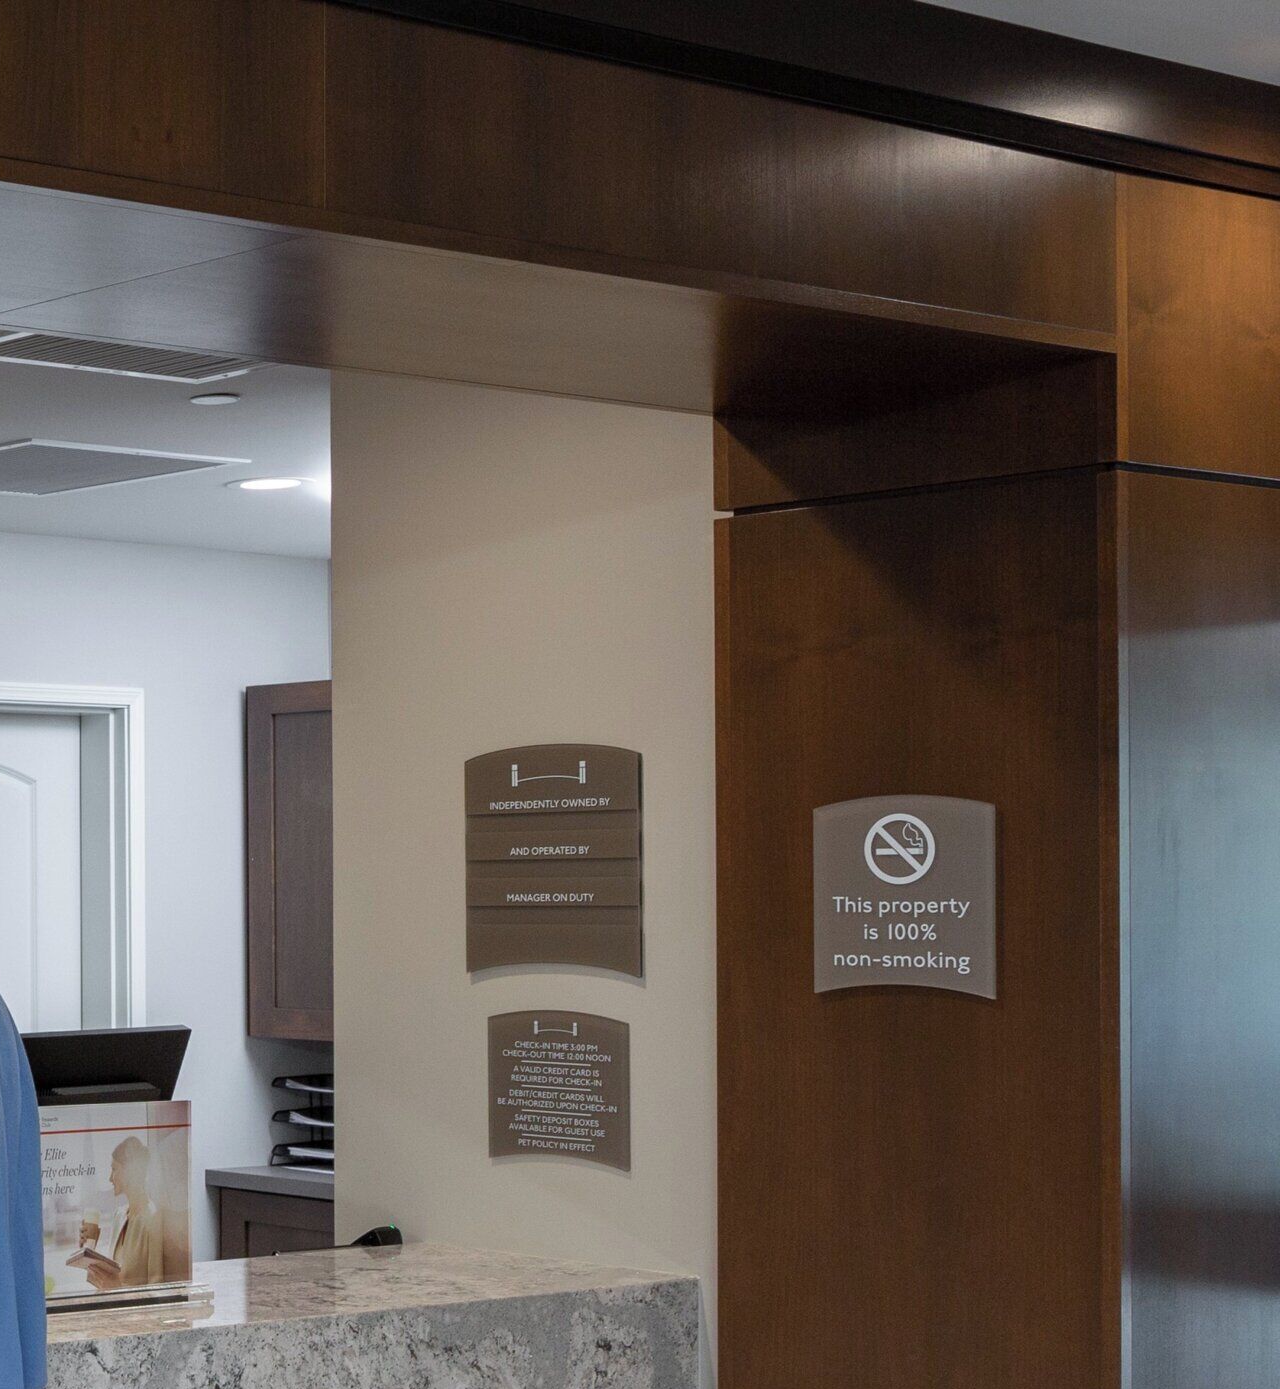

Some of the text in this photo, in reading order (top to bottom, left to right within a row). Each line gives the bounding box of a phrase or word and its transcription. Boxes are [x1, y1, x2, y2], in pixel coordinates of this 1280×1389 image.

[490, 798, 610, 810] INDEPENDENTLY OWNED BY
[510, 846, 589, 856] AND OPERATED BY
[507, 893, 594, 902] MANAGER ON DUTY
[832, 896, 970, 918] This property
[864, 924, 936, 940] is 100%
[834, 952, 970, 974] non-smoking
[515, 1041, 551, 1049] CHECK-IN
[571, 1043, 585, 1051] 3:00
[502, 1049, 546, 1058] CHECK-OUT
[586, 1054, 612, 1062] NOON
[543, 1067, 568, 1075] CREDIT
[511, 1075, 547, 1083] REQUIRED
[565, 1078, 602, 1086] CHECK-IN
[509, 1090, 604, 1103] DEBIT/CREDIT CARDS WILL
[508, 1098, 554, 1108] AUTHORIZED
[556, 1102, 578, 1110] UPON
[580, 1104, 618, 1113] CHECK-IN
[515, 1114, 599, 1127] SAFETY DEPOSIT BOXES
[509, 1123, 547, 1132] AVAILABLE
[565, 1127, 589, 1136] GUEST
[591, 1129, 605, 1137] USE
[532, 1140, 558, 1148] POLICY
[570, 1143, 595, 1152] EFFECT
[44, 1149, 67, 1160] Elite
[41, 1164, 95, 1180] rity check-in
[55, 1183, 75, 1194] here
